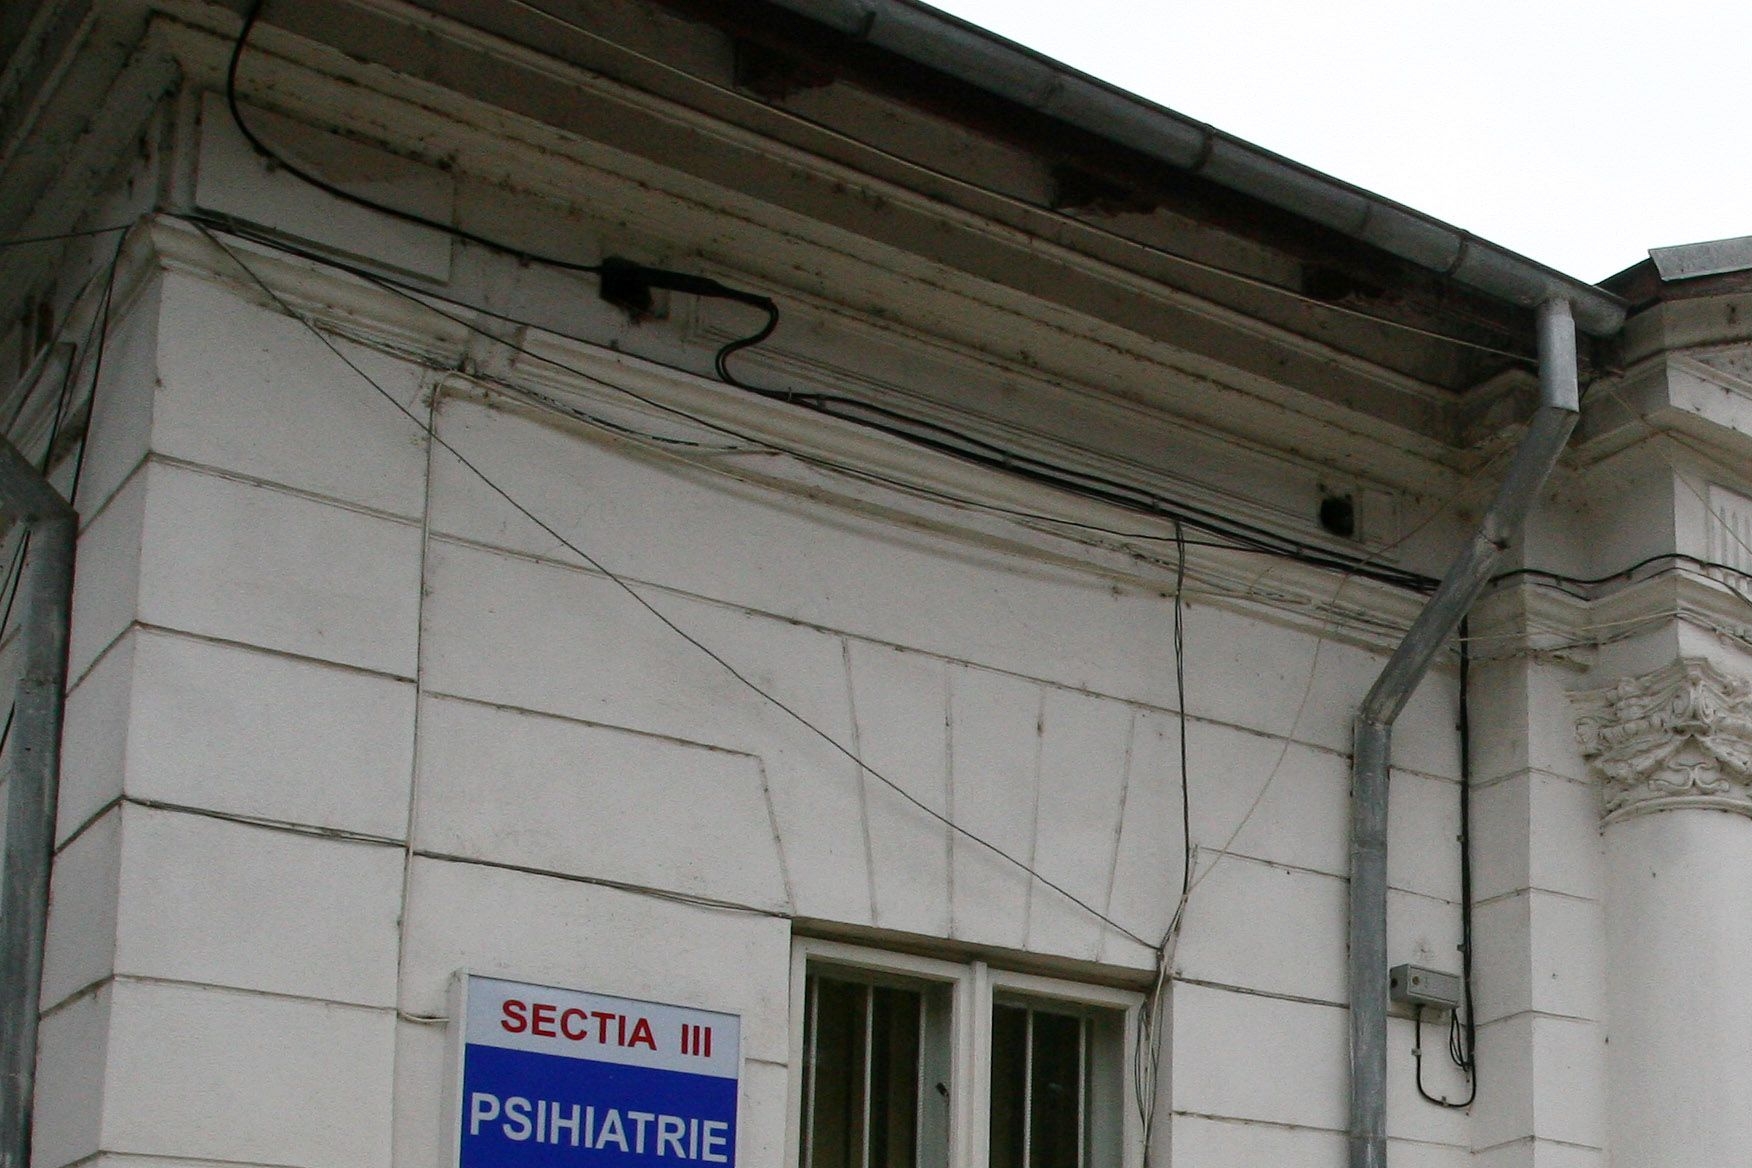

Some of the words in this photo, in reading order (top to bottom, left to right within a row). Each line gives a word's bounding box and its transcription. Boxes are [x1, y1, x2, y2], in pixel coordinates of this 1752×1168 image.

[501, 999, 657, 1051] SECTIA
[681, 1023, 712, 1057] III
[470, 1091, 729, 1163] PSIHIATRIE
